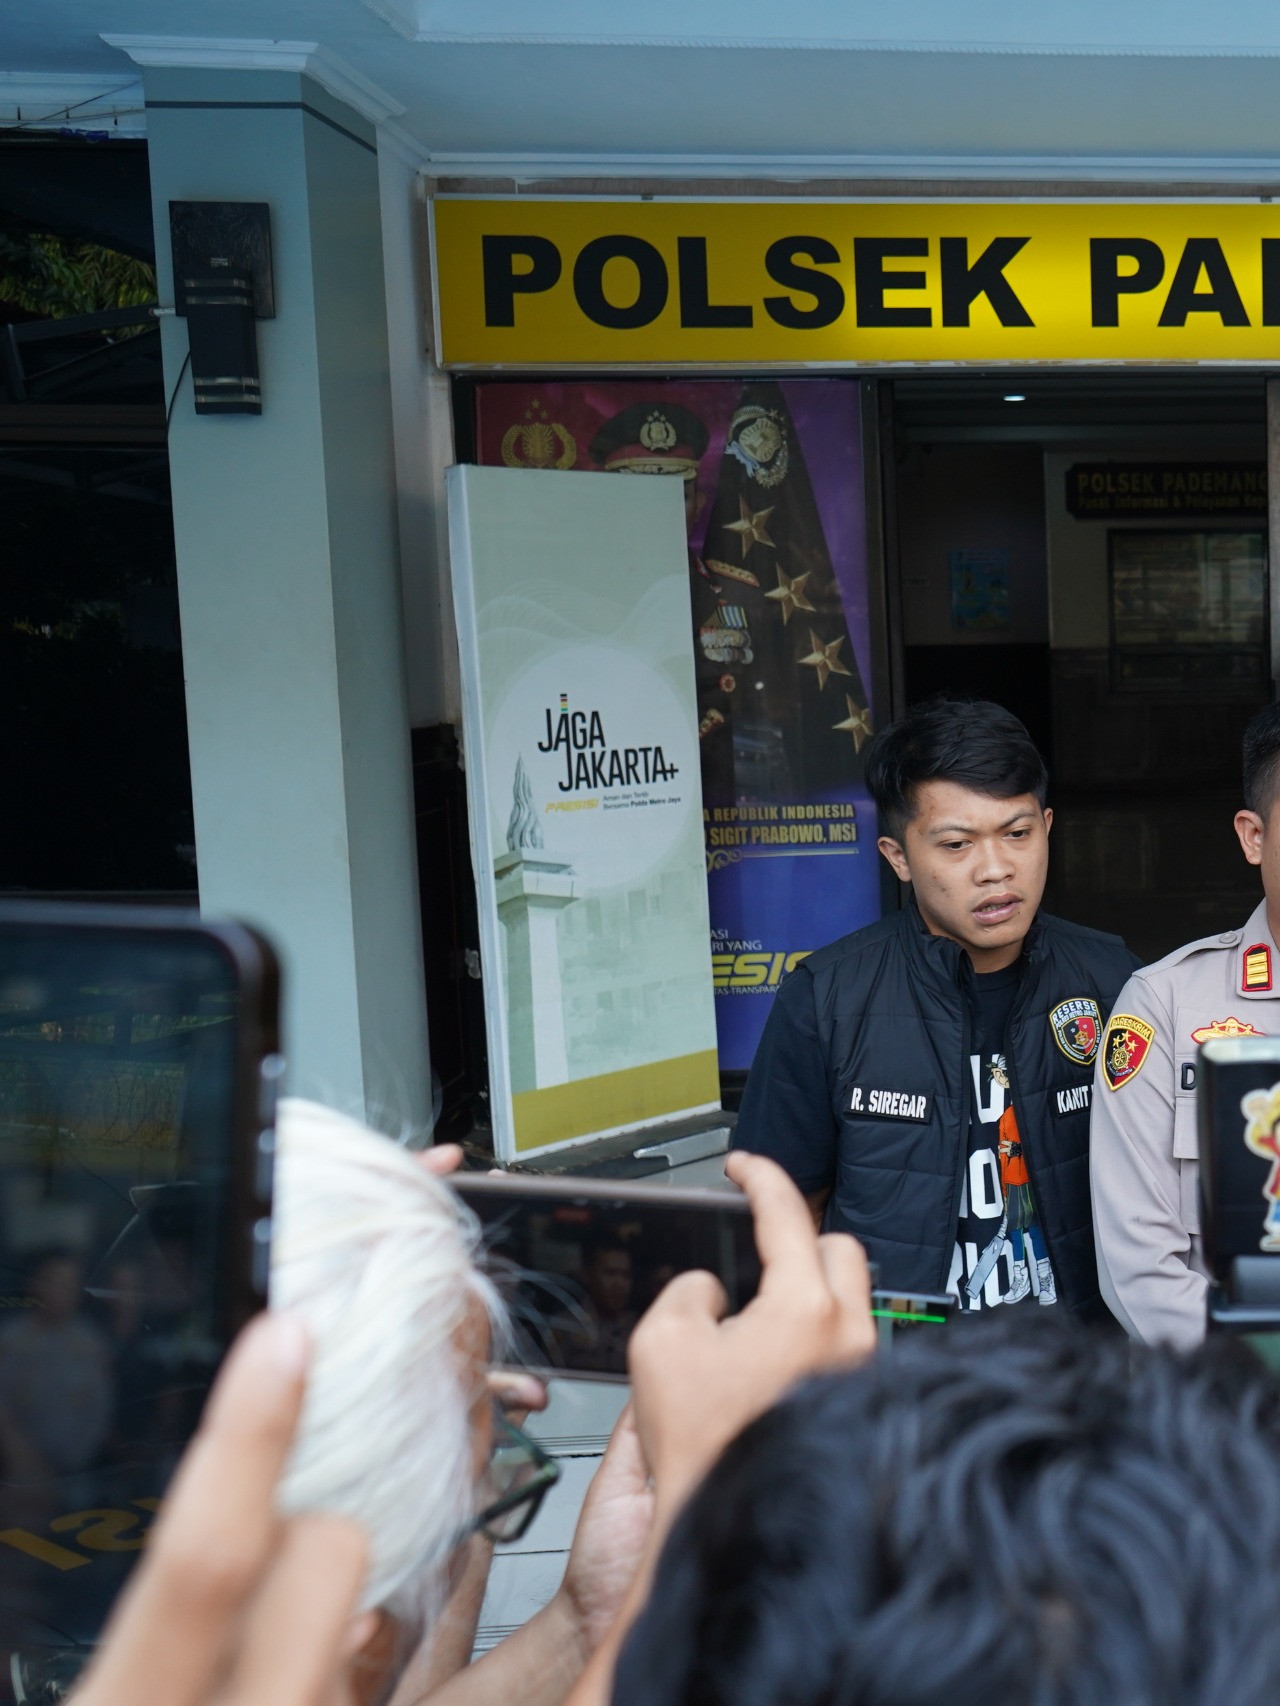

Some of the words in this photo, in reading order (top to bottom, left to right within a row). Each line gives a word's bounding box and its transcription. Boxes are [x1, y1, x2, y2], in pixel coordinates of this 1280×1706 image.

[482, 235, 1036, 329] POLSEK
[1077, 473, 1155, 493] POLSEK
[538, 708, 606, 753] JAGA
[546, 798, 599, 813] PRESISI
[603, 802, 629, 811] Bersama
[630, 800, 648, 808] Polda
[649, 798, 666, 806] Metro
[667, 796, 682, 805] Jaya
[714, 806, 779, 822] REPUBLIK
[782, 804, 855, 820] INDONESIA
[710, 826, 750, 846] SIGIT
[751, 824, 827, 844] PRABOWO,
[829, 823, 857, 842] MSi
[711, 929, 729, 940] ASI
[726, 940, 762, 951] YANG
[1052, 1000, 1097, 1024] RESERSE
[1111, 1017, 1152, 1038] BARESKRIM
[850, 1087, 864, 1112] R.
[868, 1089, 927, 1119] SIREGAR
[1056, 1085, 1089, 1114] KANIT
